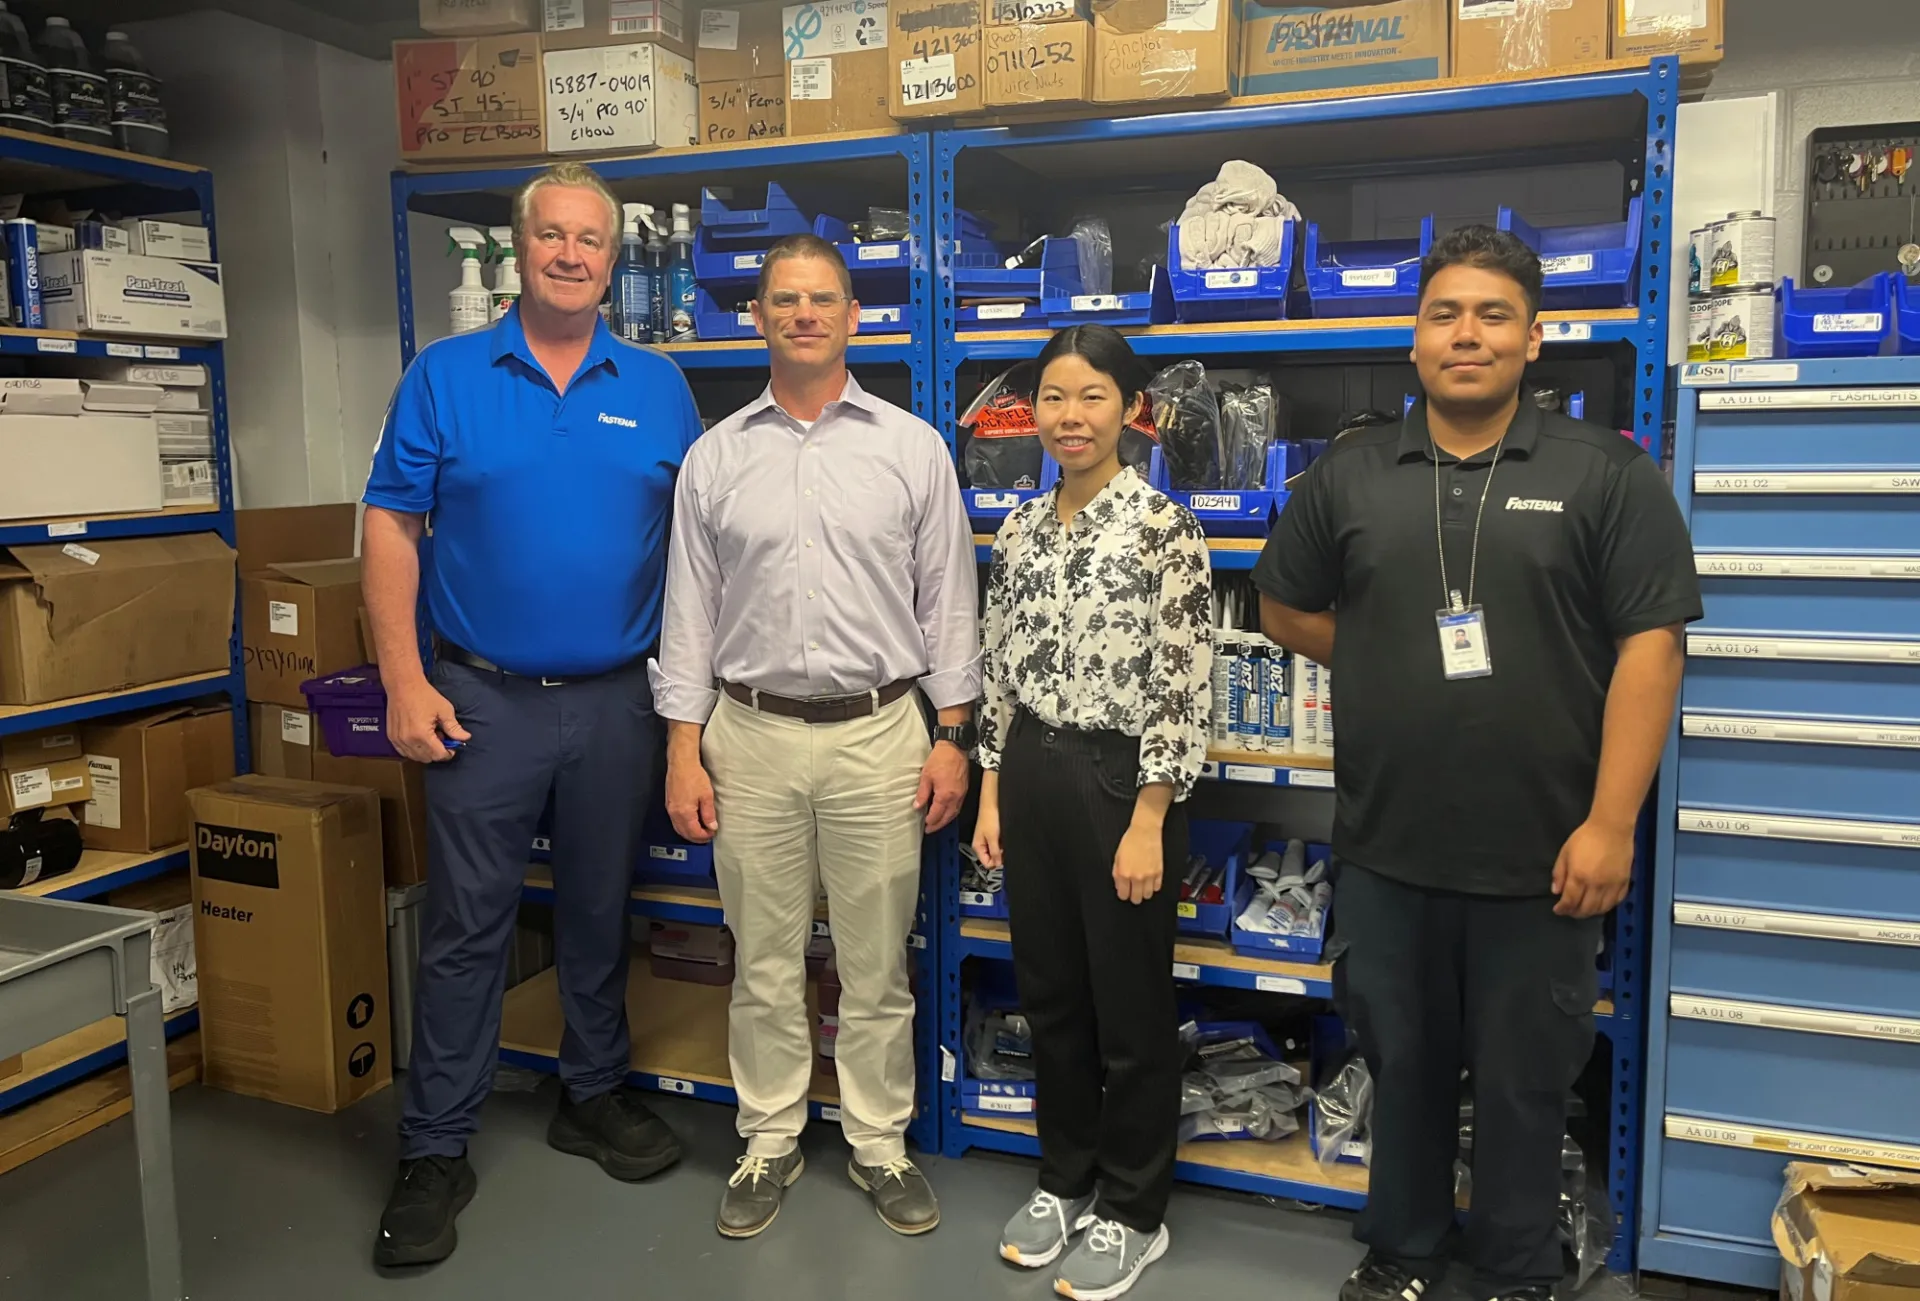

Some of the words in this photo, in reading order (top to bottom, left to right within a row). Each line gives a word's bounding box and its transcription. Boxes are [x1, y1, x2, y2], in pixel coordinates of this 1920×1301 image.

[1296, 54, 1330, 65] INDUSTRY
[1354, 47, 1397, 58] INNOVATION
[430, 68, 460, 91] ST
[549, 72, 652, 95] 15887-04019
[433, 97, 464, 118] ST
[27, 246, 39, 290] Grease
[126, 274, 186, 292] Pan-Treat
[598, 412, 638, 428] FASTENAL
[1714, 479, 1732, 488] AA
[1734, 479, 1748, 488] 01
[1753, 479, 1768, 488] 02
[1505, 496, 1565, 513] FASTENAL
[1707, 562, 1726, 571] AA
[1729, 562, 1743, 571] 01
[1747, 563, 1763, 572] 03
[1705, 644, 1722, 653] AA
[1725, 644, 1739, 653] 01
[1743, 645, 1759, 654] 04
[1241, 661, 1252, 691] 230
[1270, 663, 1284, 693] 230
[1703, 723, 1721, 732] AA
[1723, 724, 1737, 733] 01
[1741, 725, 1757, 735] 05
[1696, 819, 1714, 829] AA
[1716, 820, 1730, 829] 01
[1734, 821, 1750, 831] 06
[197, 827, 276, 860] Dayton
[201, 900, 254, 924] Heater
[1694, 913, 1711, 922] AA
[1714, 915, 1728, 924] 01
[1732, 916, 1747, 925] 07
[1877, 930, 1912, 940] ANCHOR
[1691, 1006, 1708, 1016] AA
[1711, 1008, 1724, 1017] 01
[1729, 1009, 1743, 1019] 08
[1874, 1025, 1897, 1034] PAINT
[1686, 1126, 1702, 1136] AA
[1705, 1128, 1718, 1138] 01
[1722, 1131, 1737, 1141] 09
[1806, 1143, 1828, 1152] JOINT
[1828, 1145, 1875, 1157] COMPOUND
